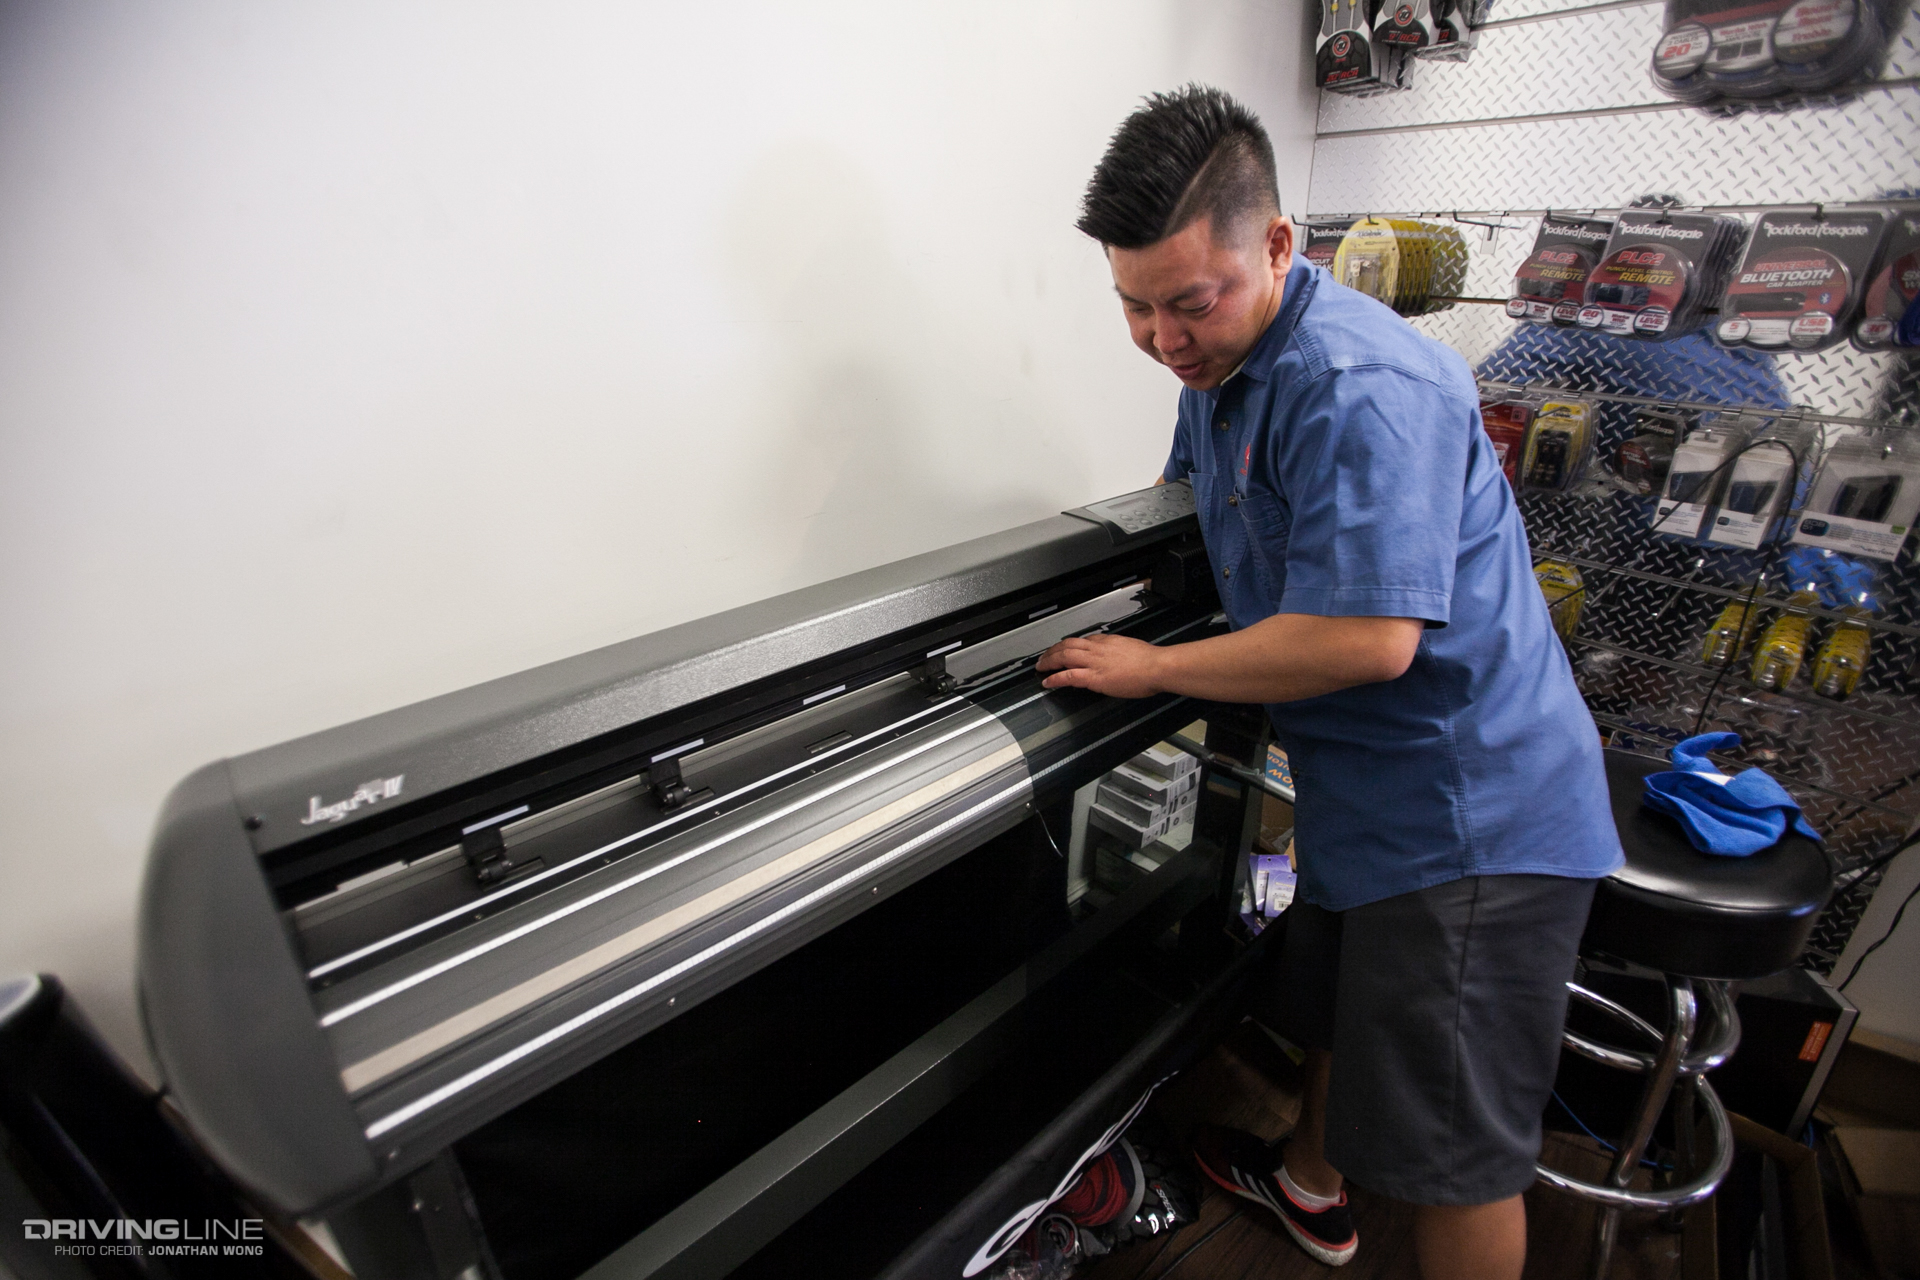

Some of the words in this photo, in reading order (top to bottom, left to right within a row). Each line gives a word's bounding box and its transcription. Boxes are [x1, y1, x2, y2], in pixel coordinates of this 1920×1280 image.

[1399, 34, 1420, 42] RCA
[1662, 43, 1692, 58] 20
[1340, 69, 1360, 78] RCA
[1619, 220, 1663, 236] Rockford
[1764, 222, 1818, 237] Rockford
[1816, 222, 1868, 237] Fosgate
[1538, 250, 1578, 265] PLC2
[1616, 250, 1666, 266] PLC2
[1754, 259, 1827, 272] UNIVERSAL
[1540, 269, 1586, 282] REMOTE
[1618, 272, 1676, 285] REMOTE
[1740, 269, 1834, 284] BLUETOOTH
[1582, 310, 1600, 318] 20
[1640, 316, 1664, 325] LEVEL
[1729, 322, 1740, 330] 5
[1798, 318, 1828, 326] USB
[300, 788, 382, 825] Jaguar
